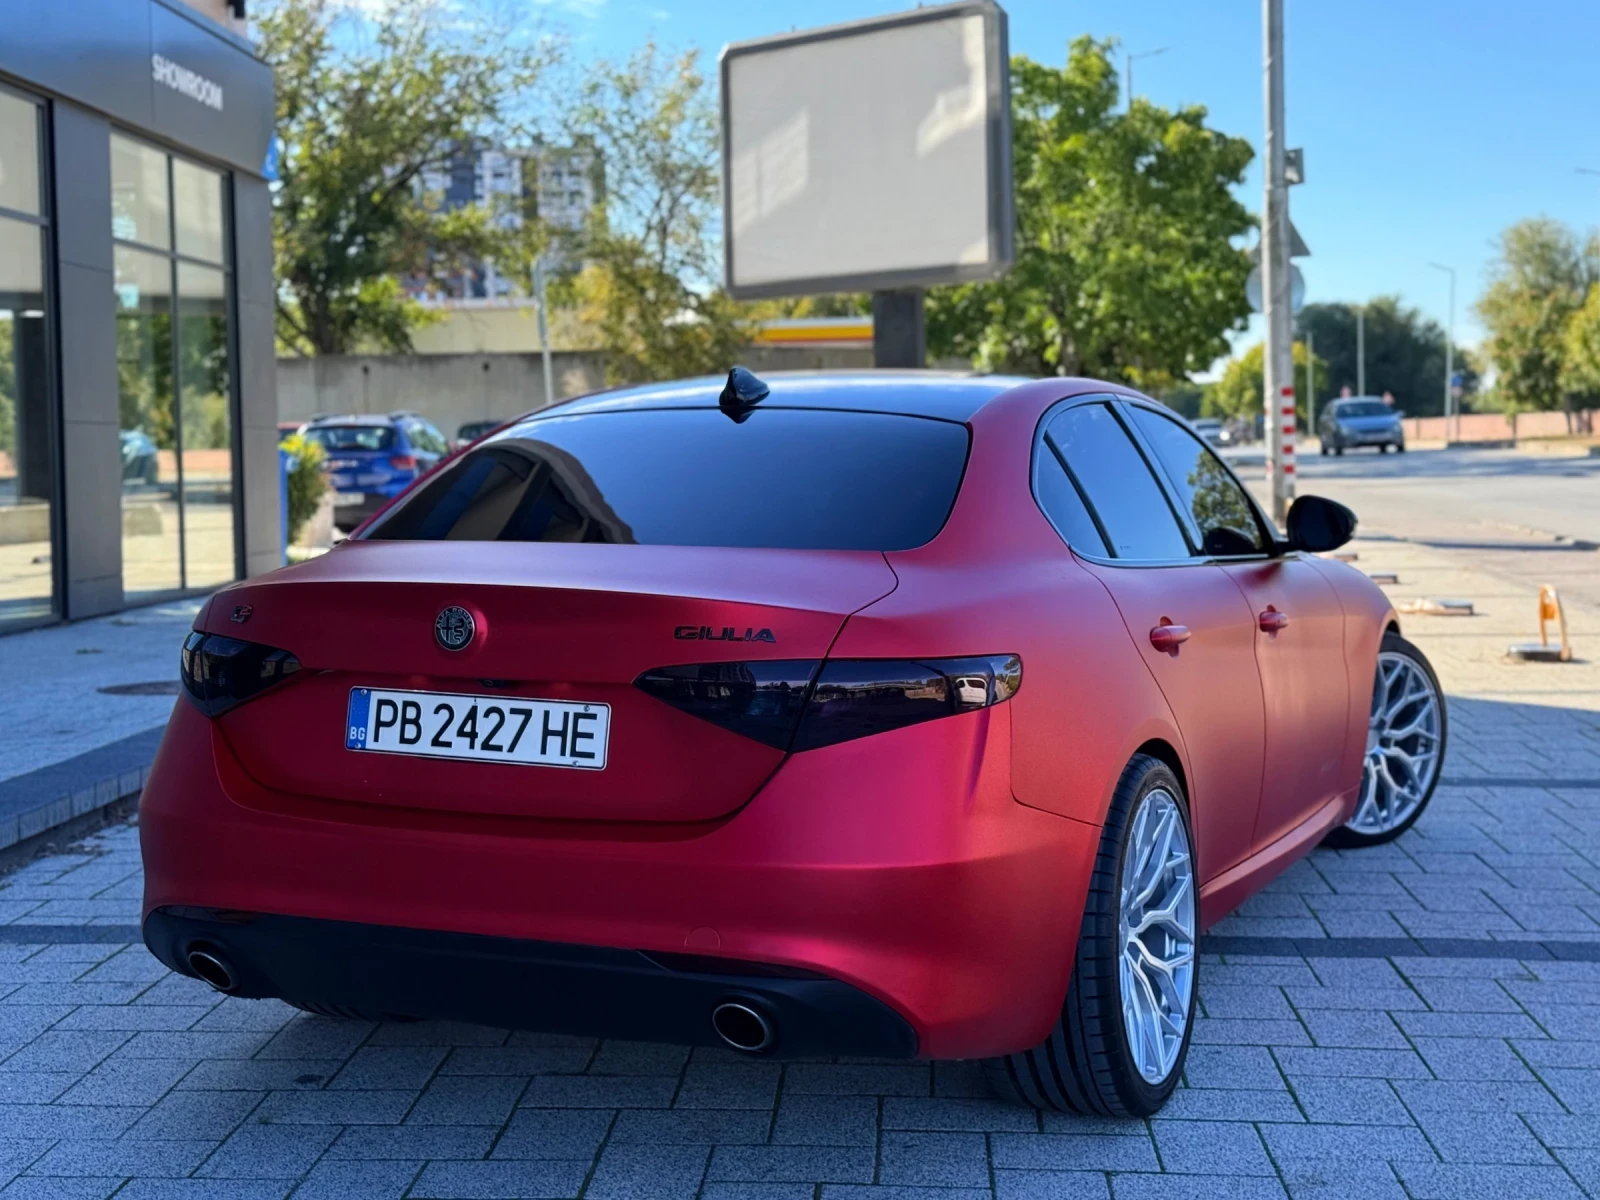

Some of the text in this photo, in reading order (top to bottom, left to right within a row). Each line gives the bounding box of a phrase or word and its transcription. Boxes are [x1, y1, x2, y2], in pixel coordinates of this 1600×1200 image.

[152, 53, 223, 112] SHOWROOM
[452, 607, 473, 630] ROMEO
[674, 626, 776, 643] GIULIA
[350, 727, 366, 740] BG
[373, 699, 598, 759] PB 2427 HE
